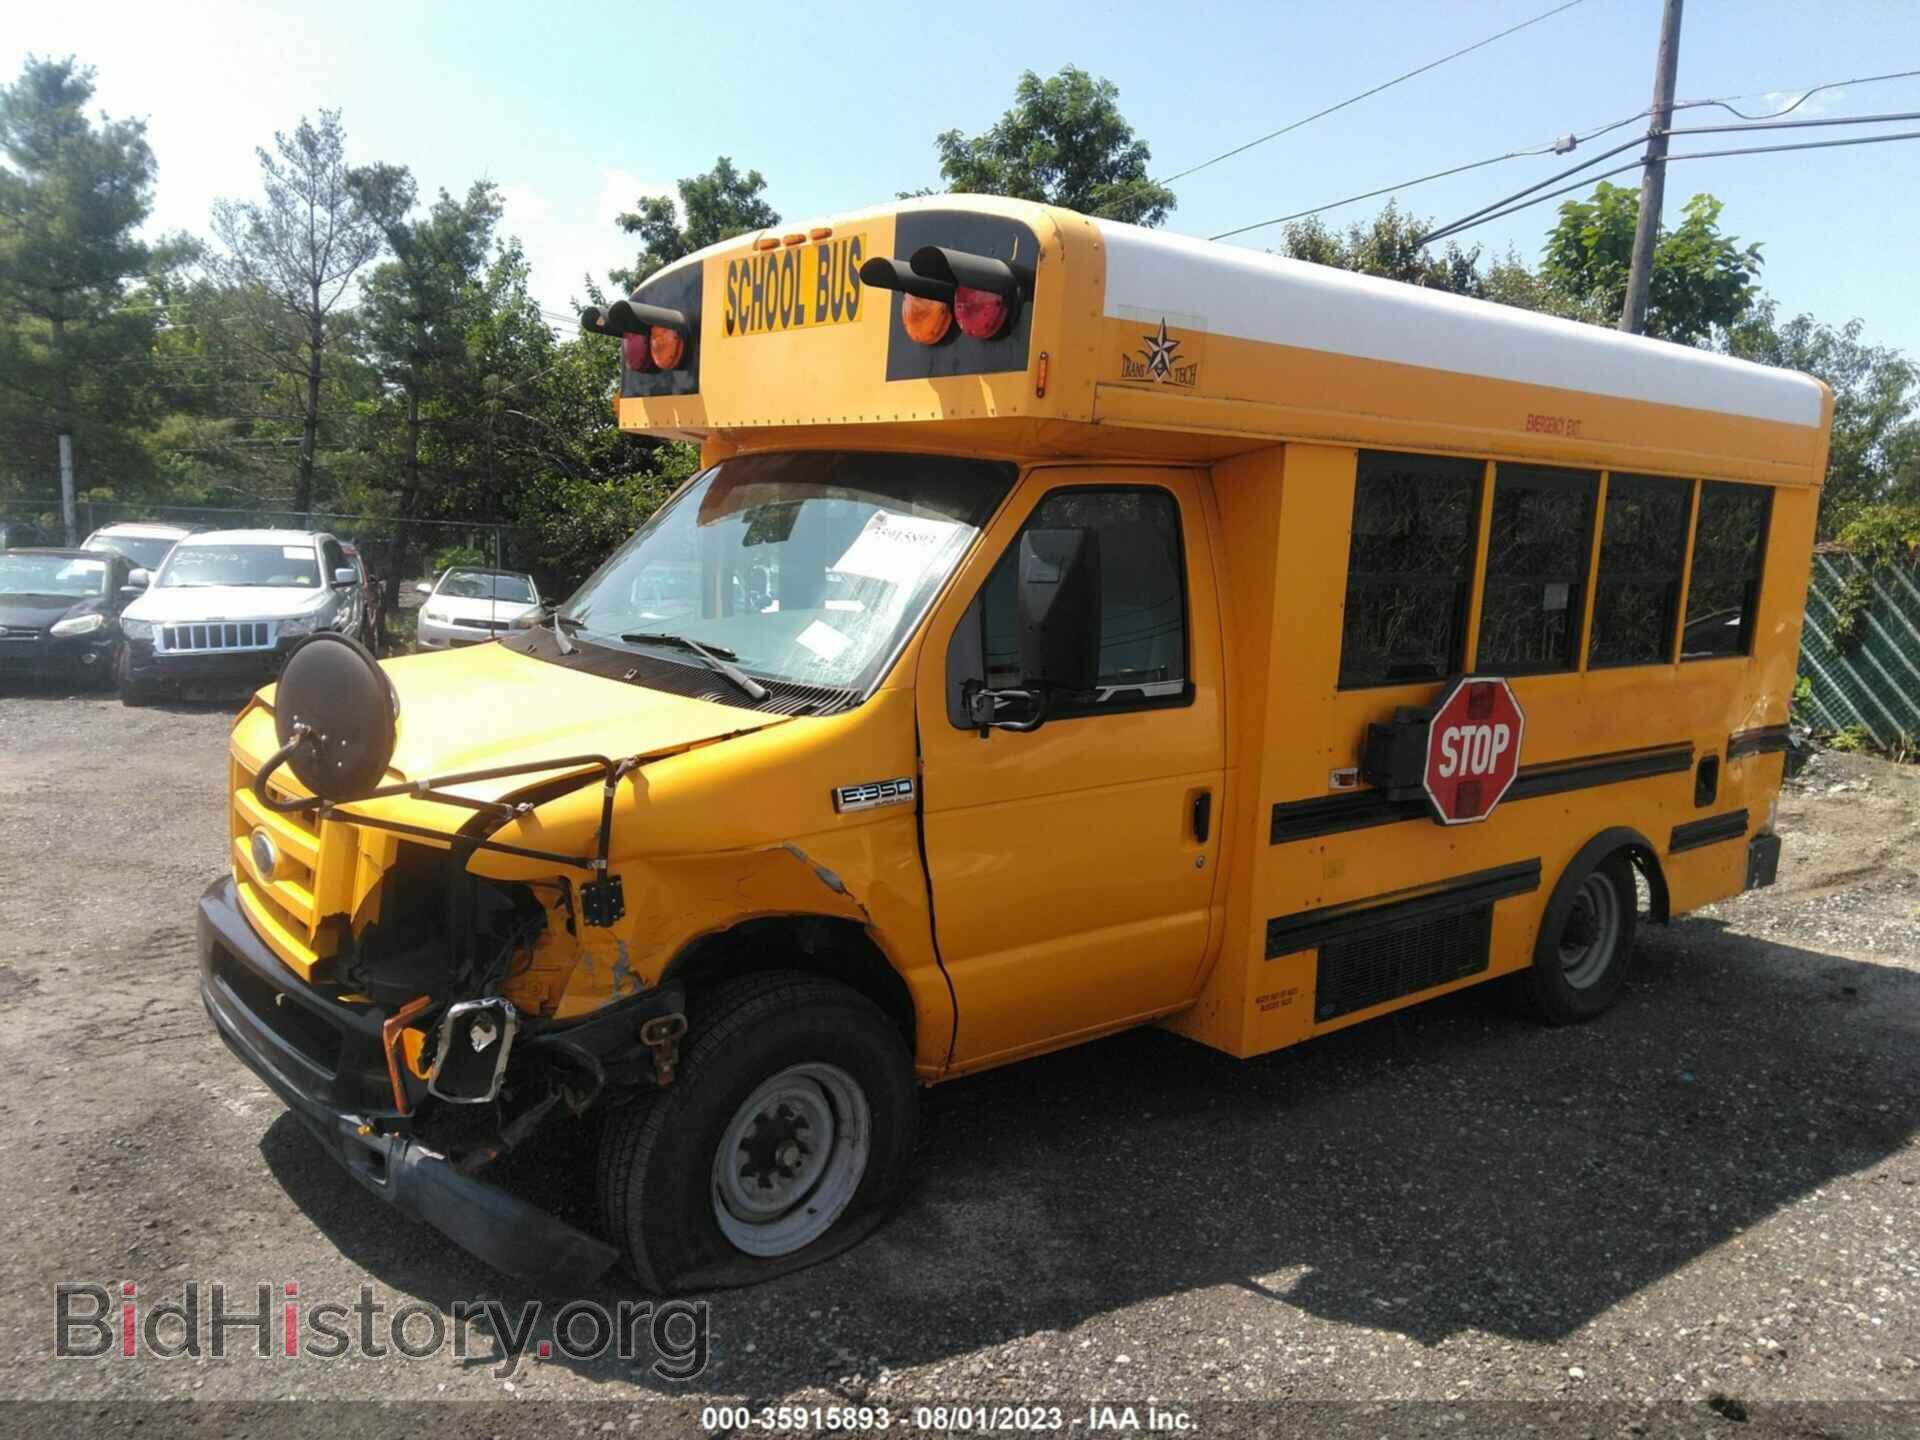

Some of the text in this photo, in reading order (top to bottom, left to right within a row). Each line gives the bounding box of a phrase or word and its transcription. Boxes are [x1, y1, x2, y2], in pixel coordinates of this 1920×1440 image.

[726, 236, 862, 335] SCHOOL BUS
[1439, 724, 1510, 777] STOP
